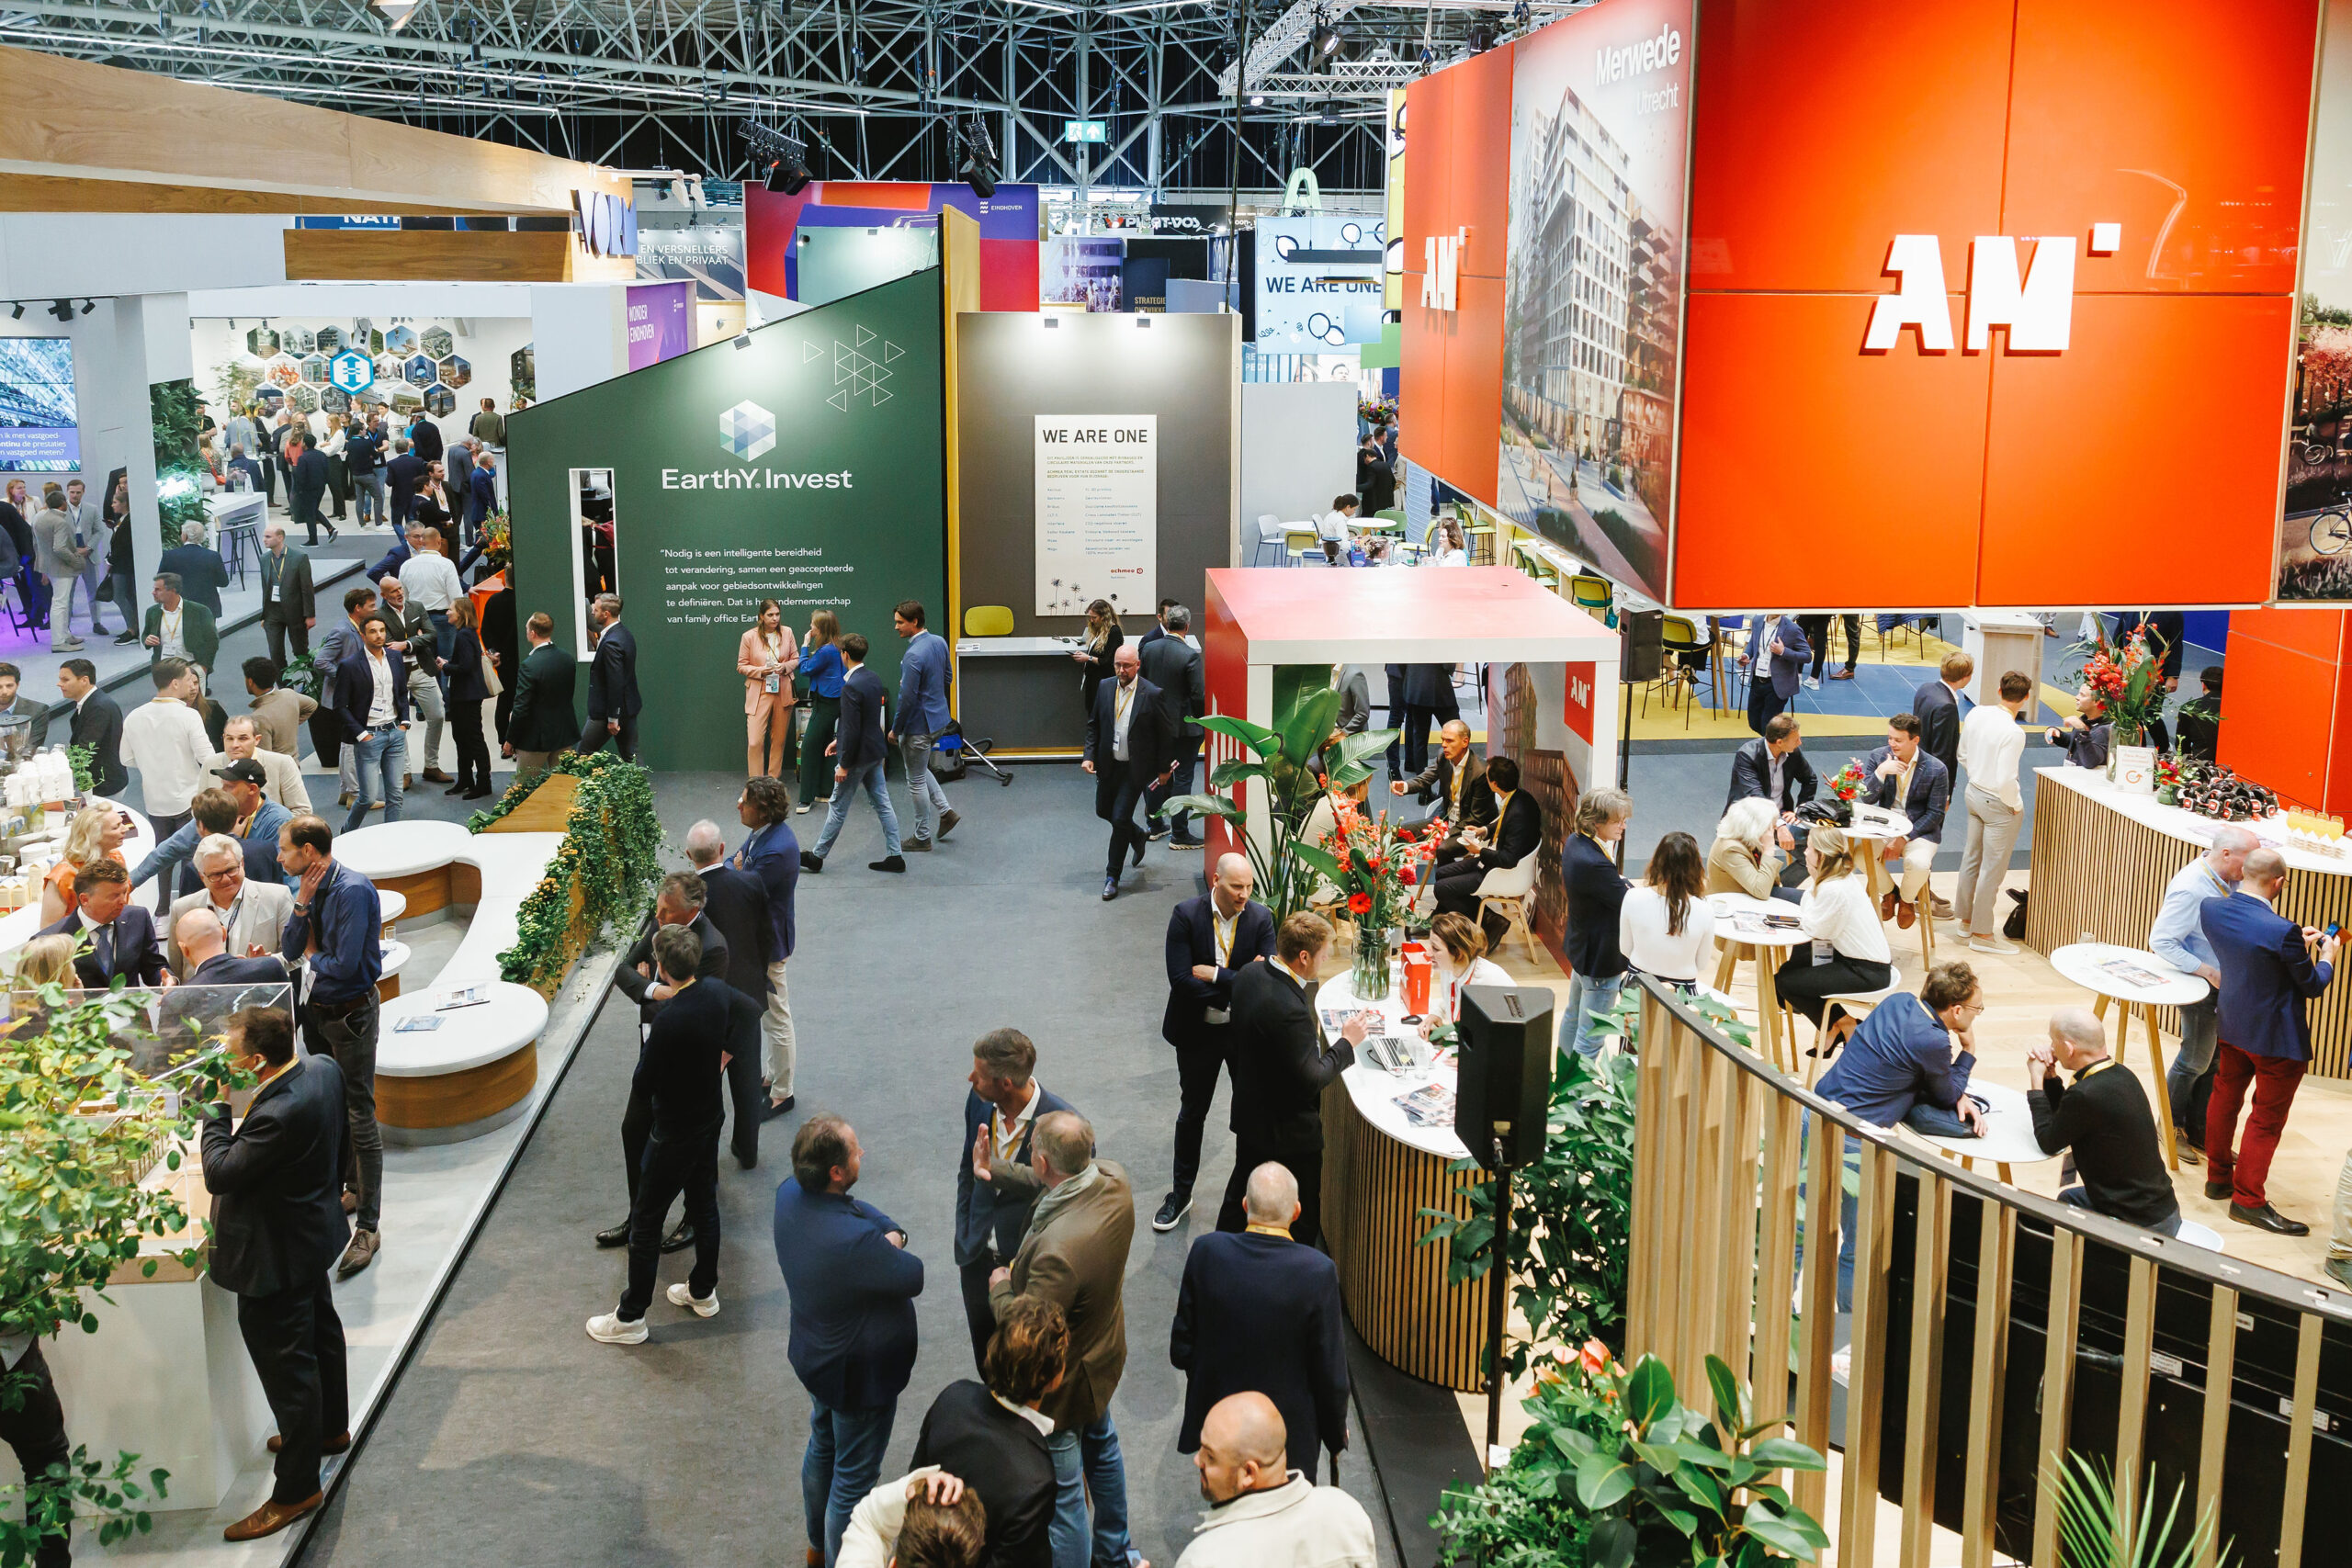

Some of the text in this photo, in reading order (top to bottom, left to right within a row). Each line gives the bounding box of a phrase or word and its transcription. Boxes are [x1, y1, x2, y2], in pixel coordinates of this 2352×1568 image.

[1596, 23, 1680, 86] Merwede
[1638, 83, 1679, 115] Utrecht
[577, 189, 639, 255] VORM
[640, 245, 728, 254] EN VERSNELLERS
[636, 255, 729, 265] BLIEK EN PRIVAAT
[1421, 236, 1457, 310] AM
[1266, 276, 1382, 293] WE ARE ONE
[1865, 234, 2076, 350] AM
[1135, 296, 1166, 304] STRATEGIE
[630, 323, 654, 343] EINDHOVEN
[28, 432, 61, 441] vastgoed-
[1043, 429, 1148, 443] WE ARE ONE
[6, 449, 37, 457] vastgoed
[765, 468, 853, 489] Invest
[695, 548, 703, 557] is
[723, 548, 773, 558] intelligente
[775, 547, 822, 557] bereidheid
[681, 566, 736, 575] verandering,
[788, 564, 854, 575] geaccepteerde
[665, 581, 697, 592] aanpak
[722, 581, 823, 592] gebiedsontwikkelingen
[666, 599, 675, 607] te
[678, 597, 725, 606] definiëren.
[727, 598, 743, 606] Dat
[746, 597, 753, 605] is
[777, 597, 851, 607] ndernemerschap
[684, 615, 711, 625] family
[714, 614, 739, 623] office
[1570, 675, 1587, 709] AM
